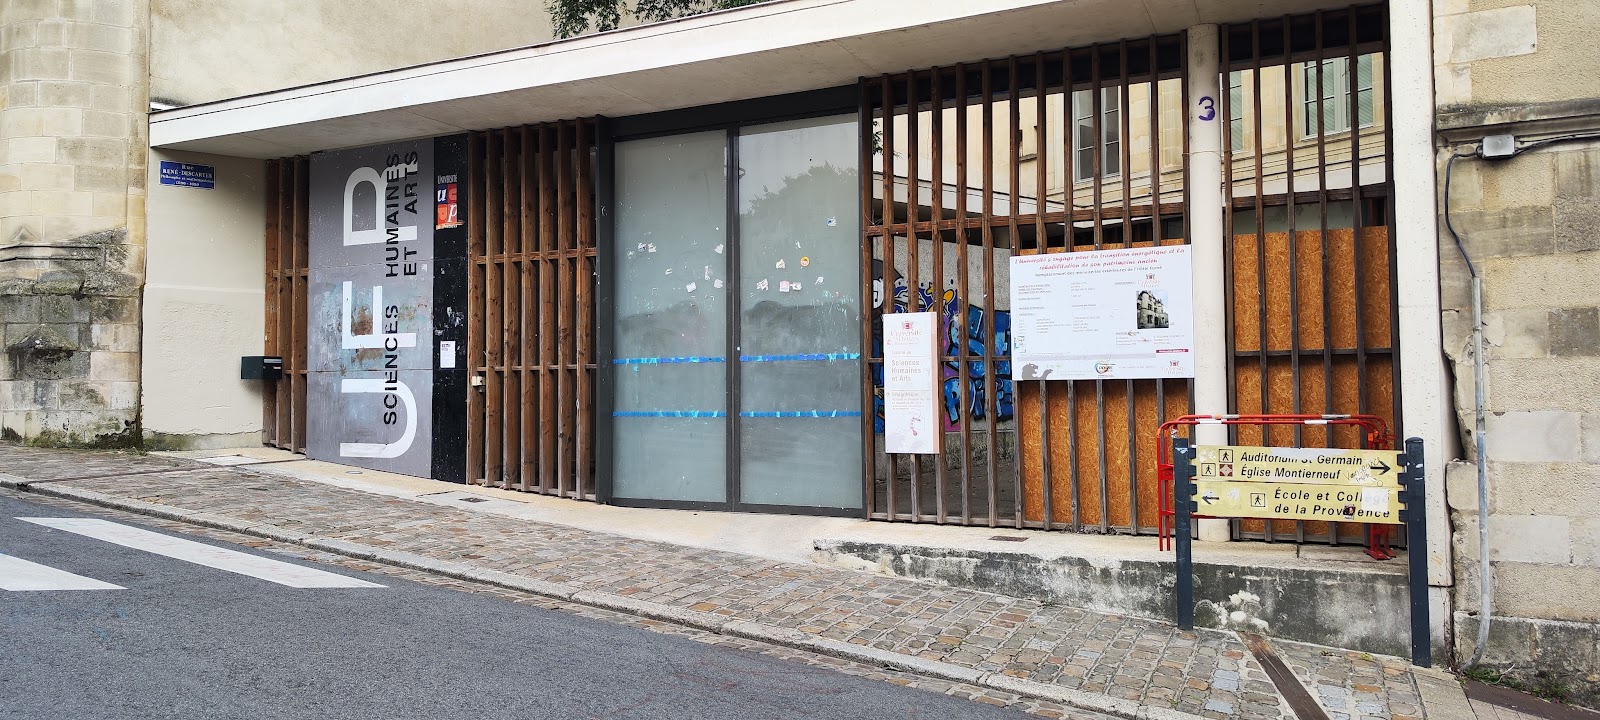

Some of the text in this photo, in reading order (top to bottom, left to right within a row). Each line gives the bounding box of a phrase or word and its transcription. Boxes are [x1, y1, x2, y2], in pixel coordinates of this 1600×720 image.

[1199, 96, 1215, 121] 3
[403, 150, 418, 276] ET ARTS
[1039, 262, 1080, 270] réhabilitation
[1102, 259, 1135, 267] patrimoine
[383, 153, 400, 425] SCIENCES HUMAINES
[340, 163, 418, 459] UFR
[1317, 454, 1363, 465] Germain
[1241, 463, 1271, 479] Église
[1275, 467, 1341, 480] Montierneuf
[1274, 486, 1310, 500] École
[1316, 492, 1330, 501] et
[1274, 503, 1390, 518] de la Provence
